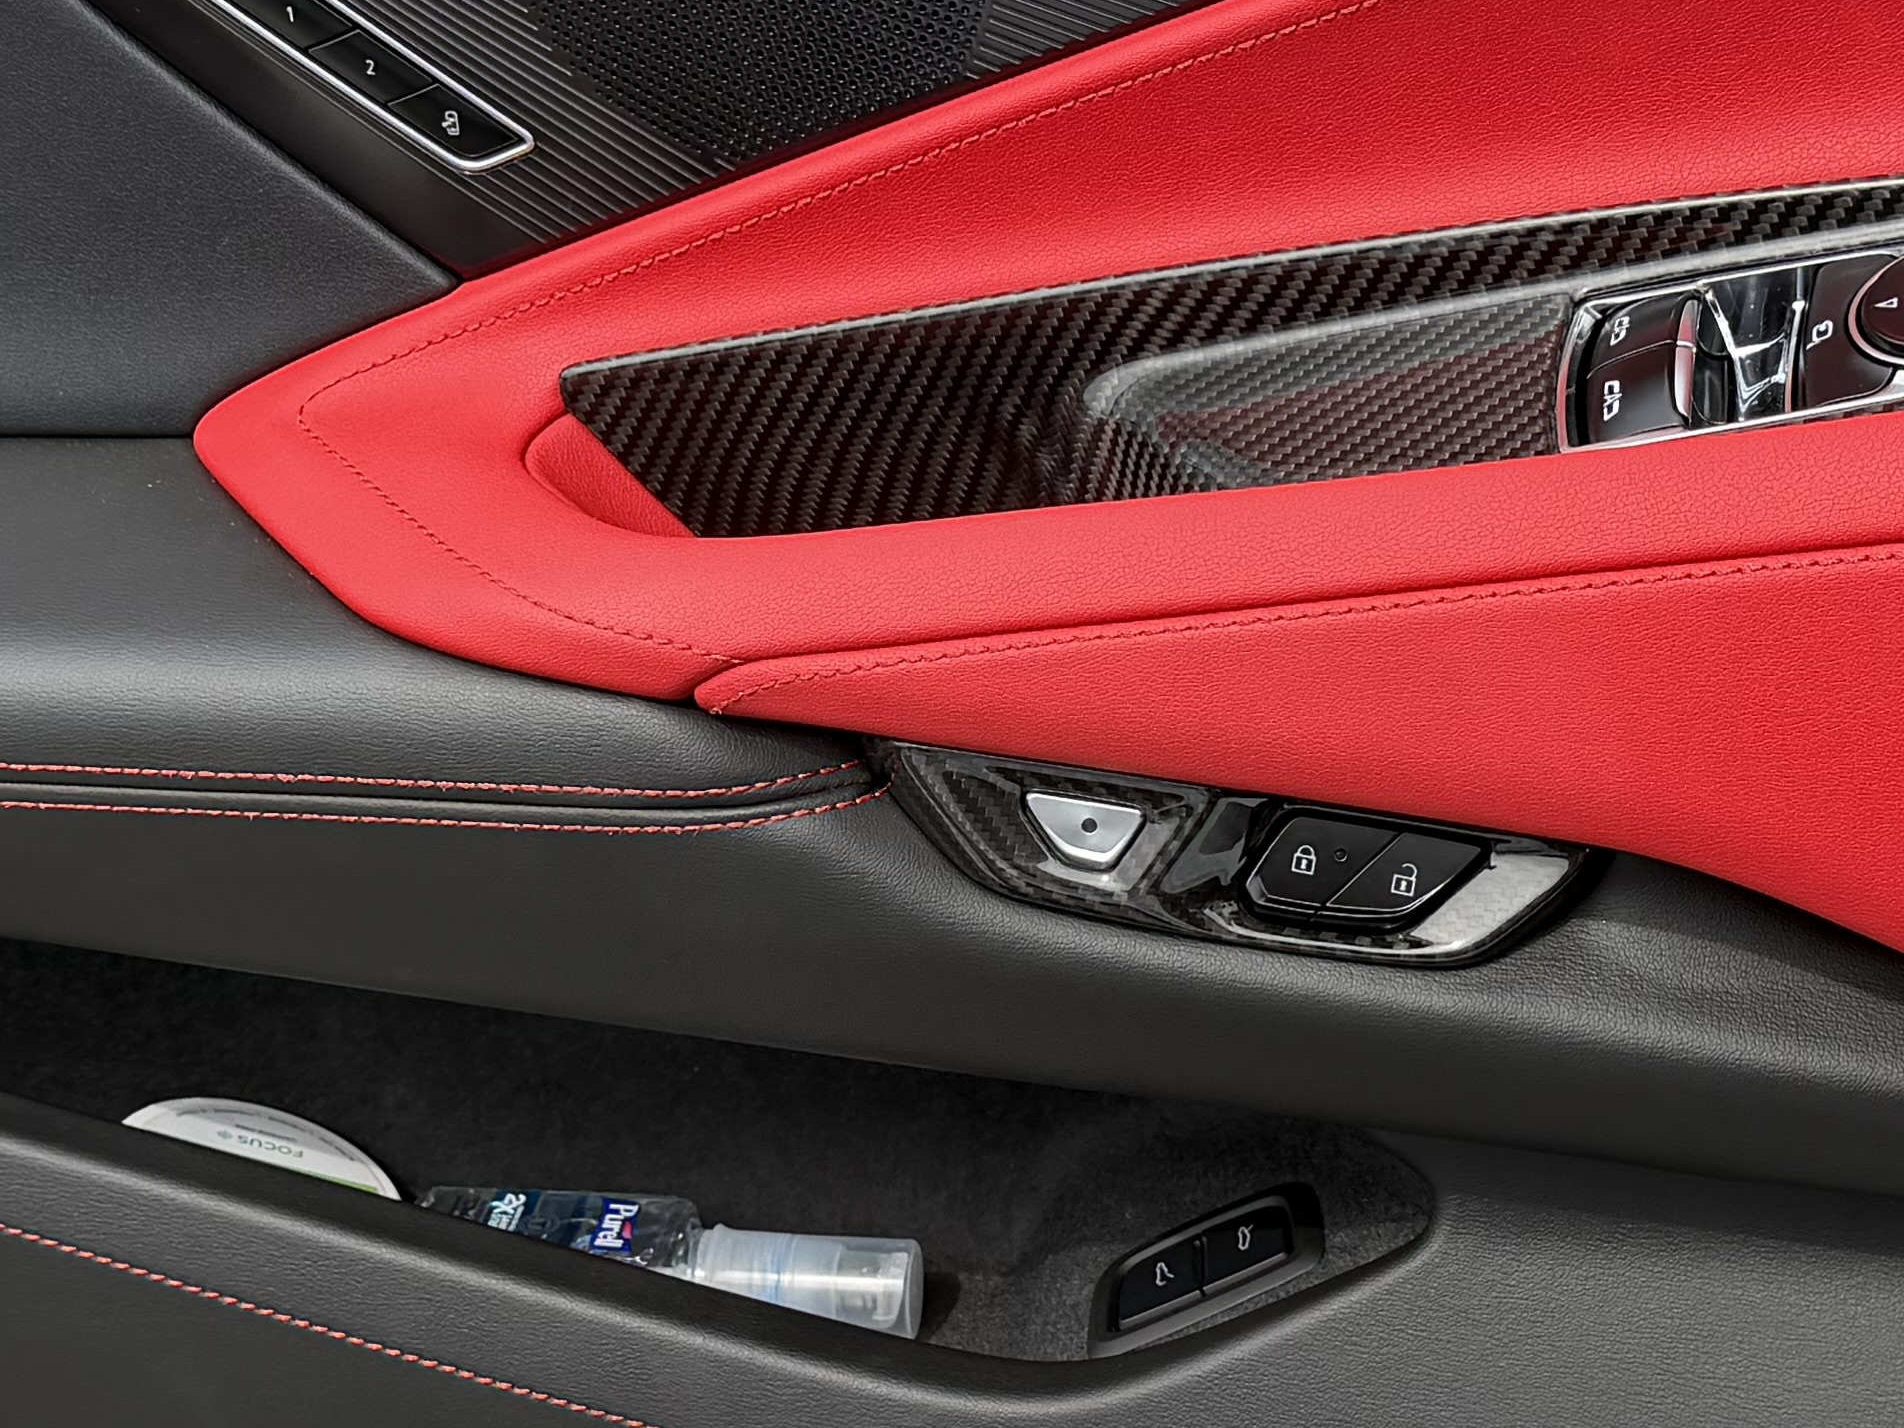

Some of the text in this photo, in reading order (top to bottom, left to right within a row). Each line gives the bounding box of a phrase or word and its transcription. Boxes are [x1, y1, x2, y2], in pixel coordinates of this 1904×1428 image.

[286, 6, 294, 22] 1
[365, 59, 376, 75] 2
[237, 1134, 304, 1158] FOCUS
[593, 1203, 639, 1248] Purell
